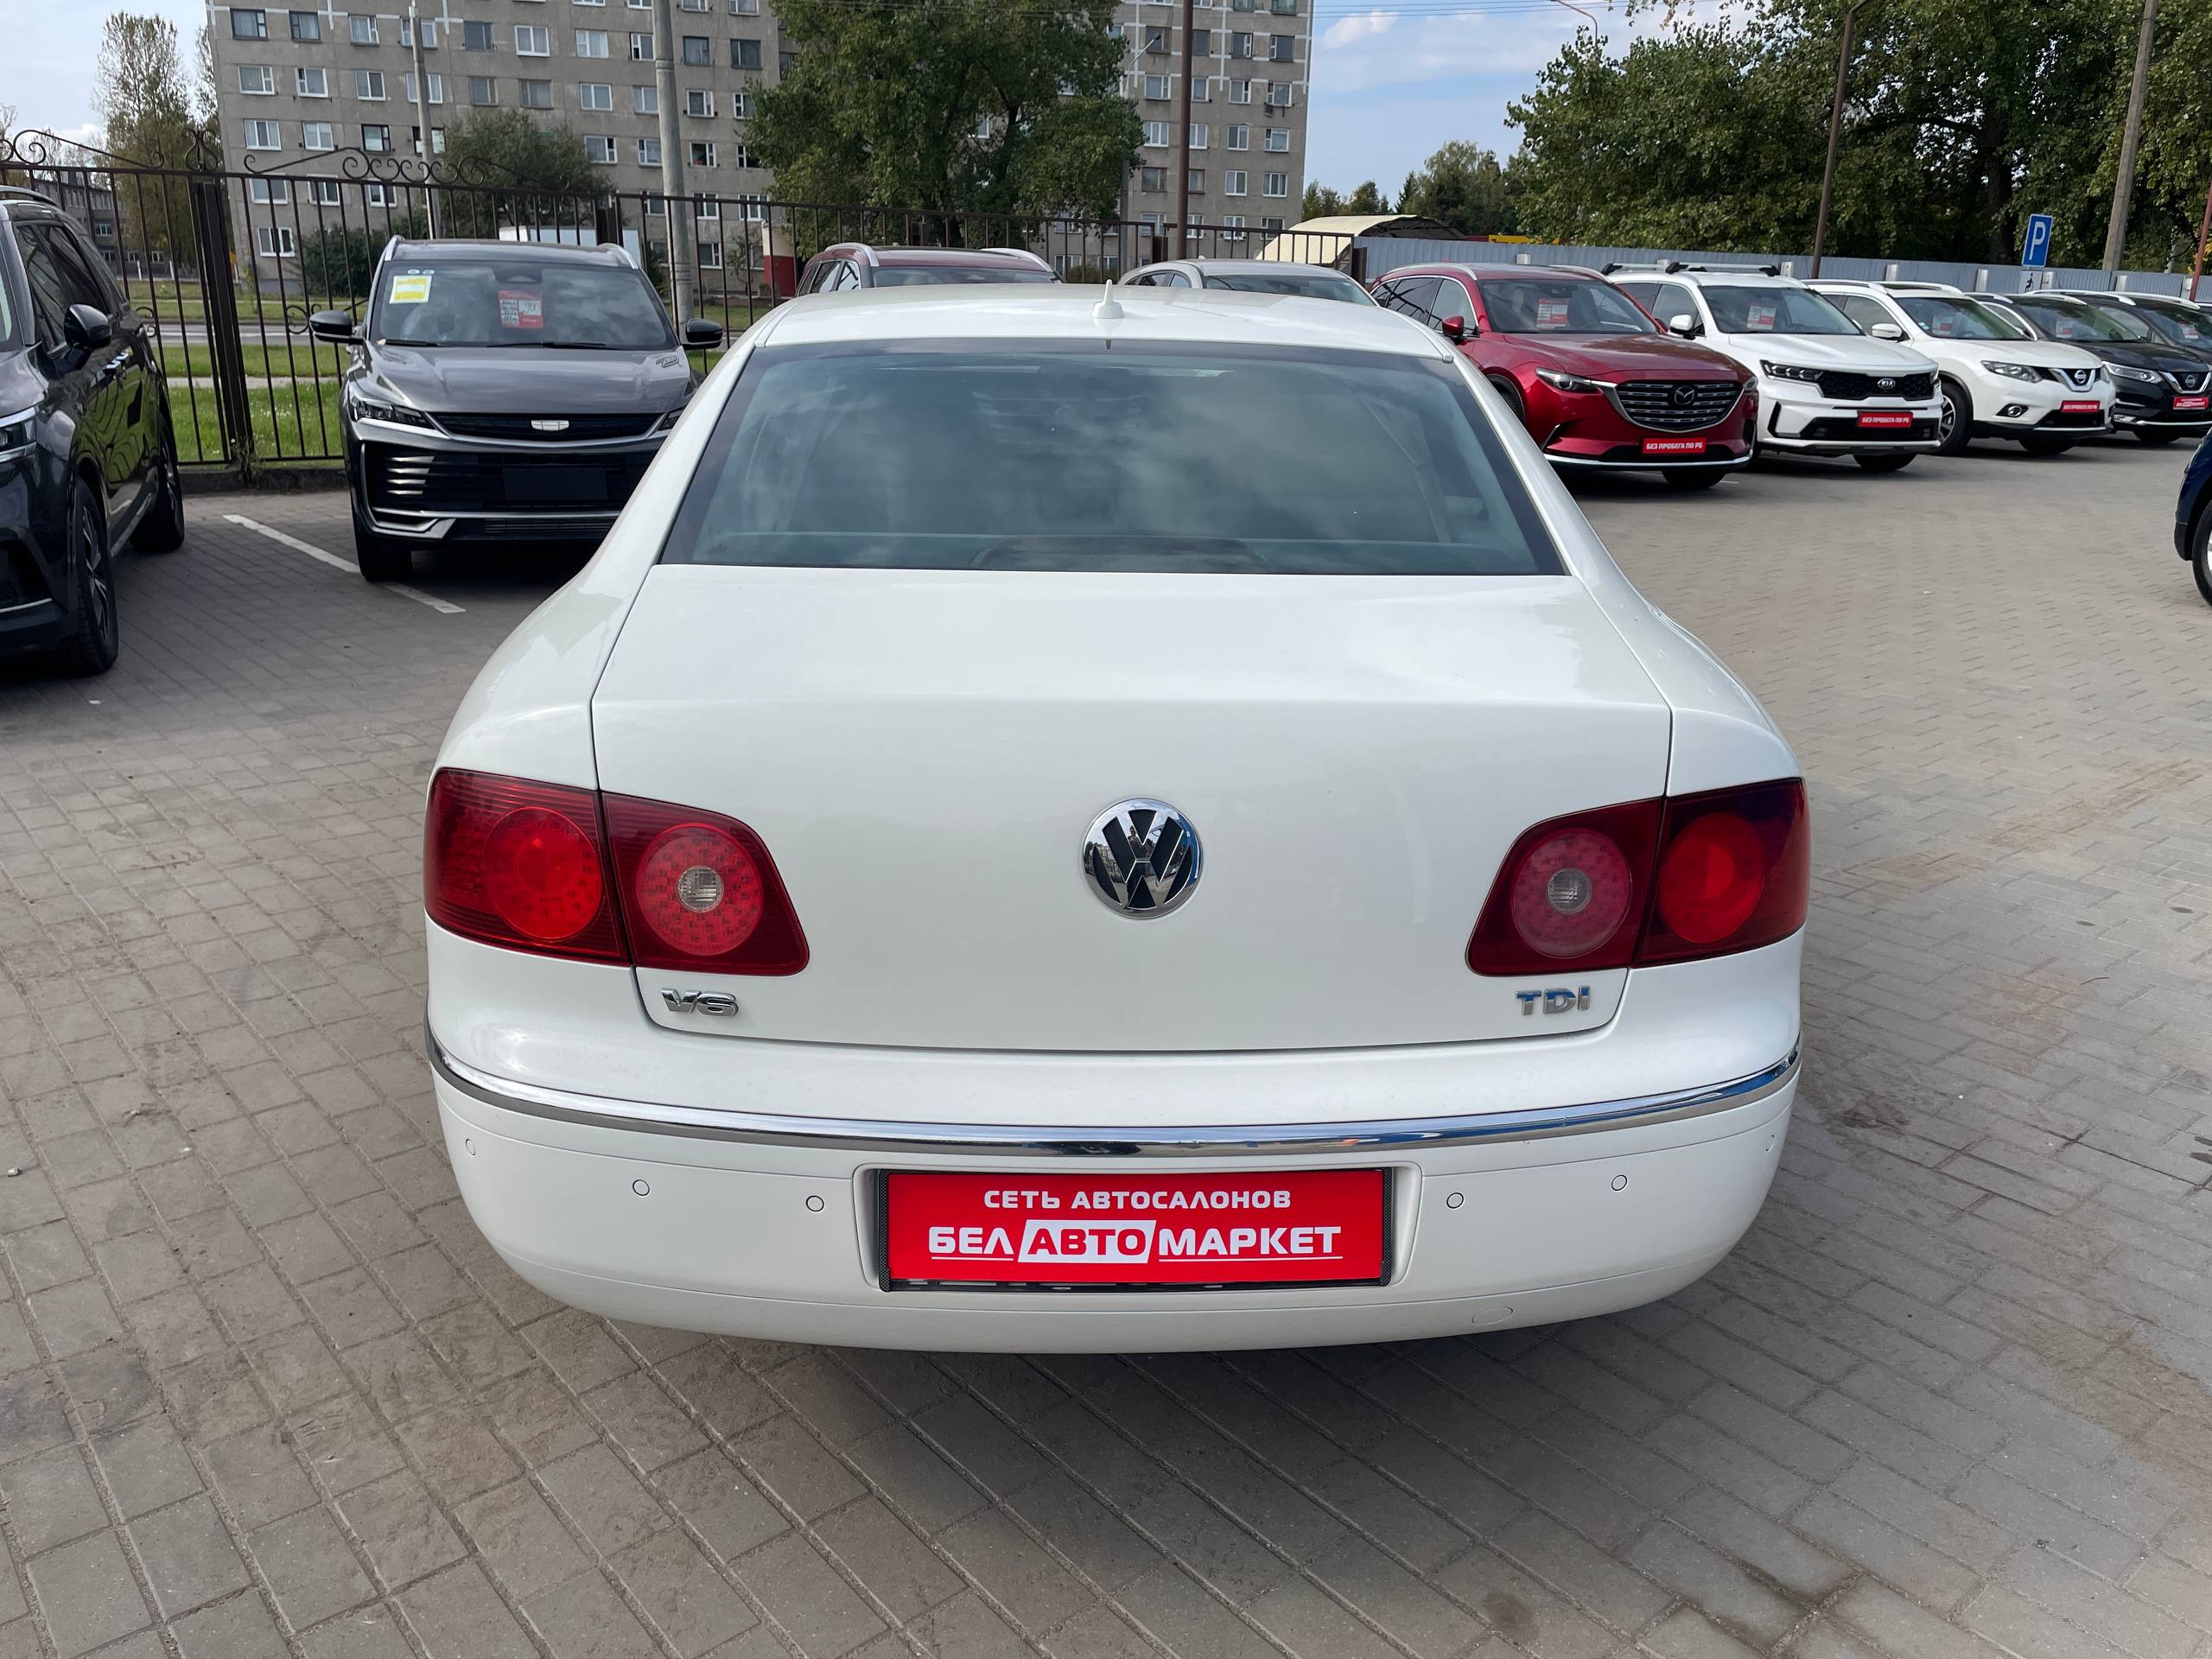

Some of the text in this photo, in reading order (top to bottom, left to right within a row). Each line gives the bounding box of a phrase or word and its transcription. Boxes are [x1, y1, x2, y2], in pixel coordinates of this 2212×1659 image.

[2029, 221, 2046, 260] P
[660, 988, 739, 1017] V6
[1515, 985, 1591, 1015] TDI
[984, 1190, 1292, 1210] СЕТЬ АВТОСАЛОНОВ
